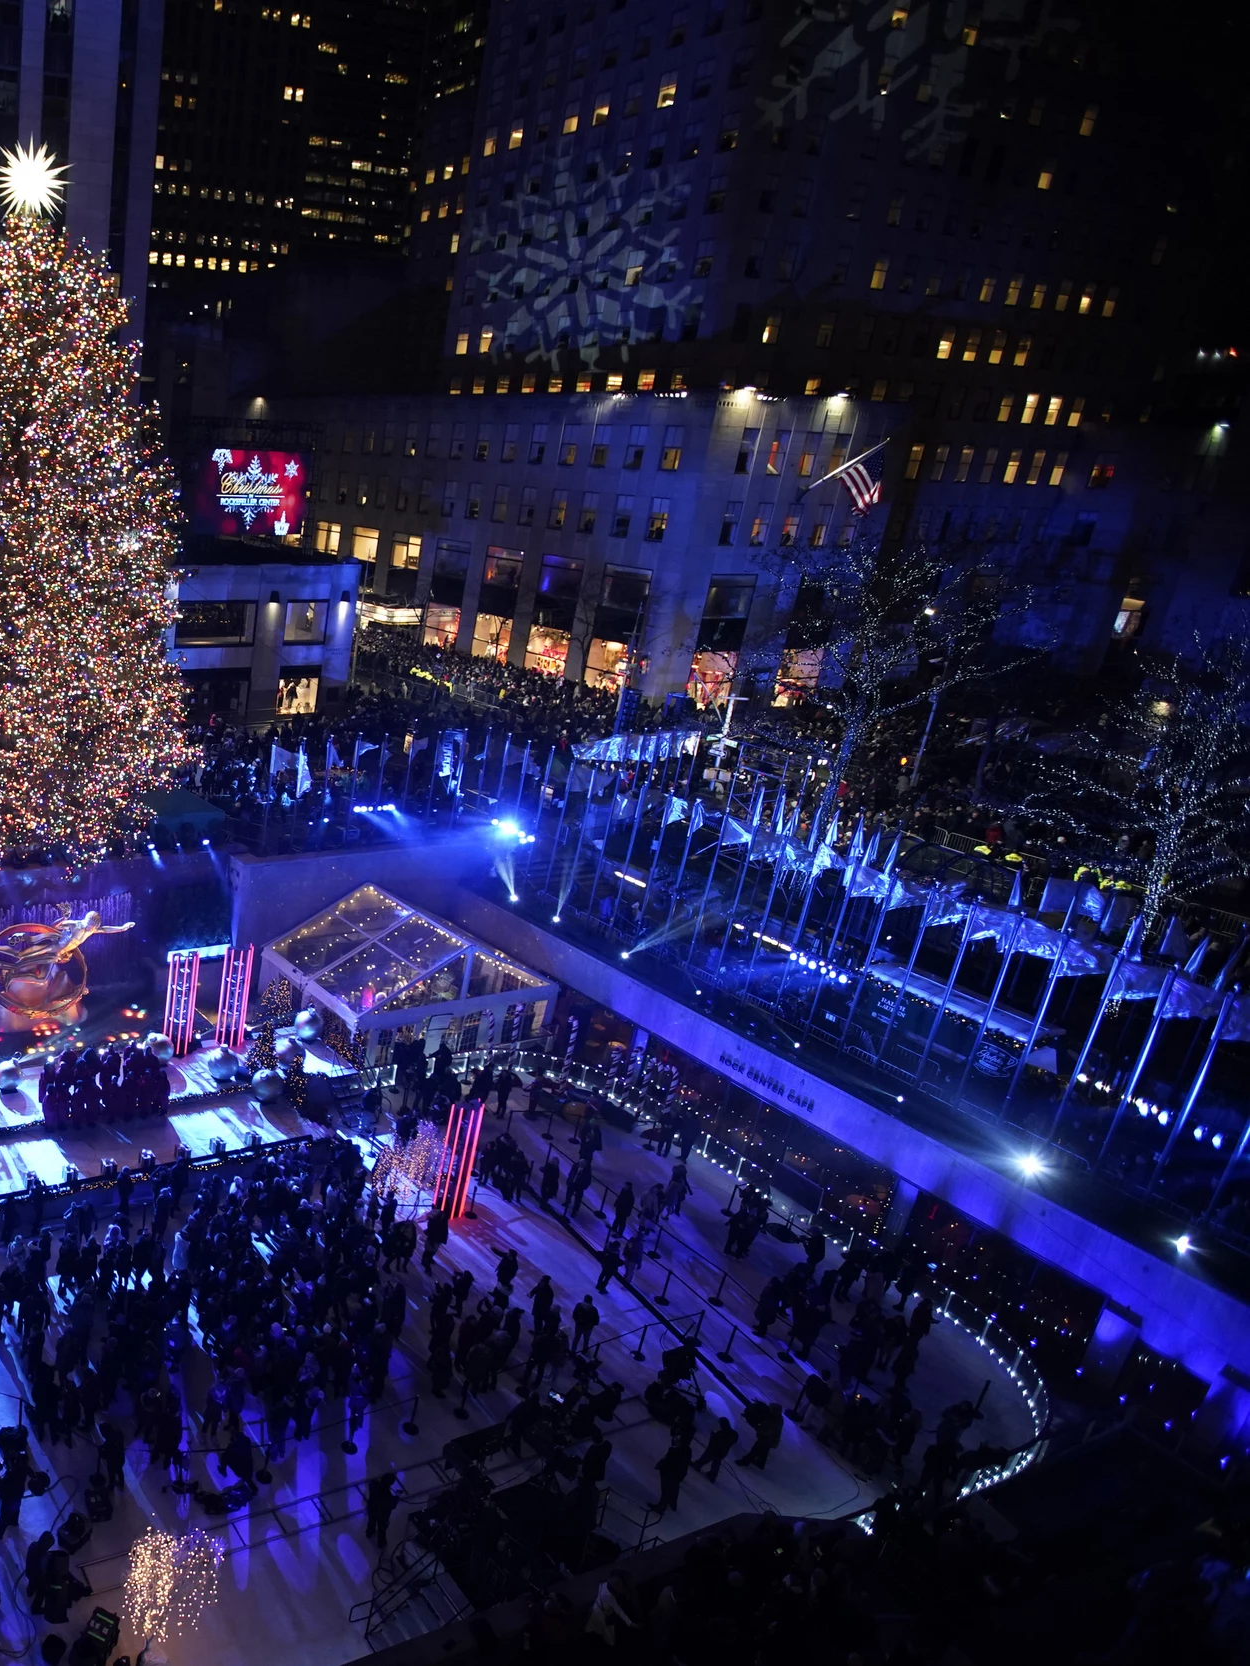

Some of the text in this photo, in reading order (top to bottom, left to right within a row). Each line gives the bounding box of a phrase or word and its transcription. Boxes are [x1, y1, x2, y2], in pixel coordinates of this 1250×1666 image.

[220, 471, 283, 495] Christmas
[258, 498, 280, 506] CENTER
[881, 997, 906, 1012] RALH
[719, 1053, 744, 1075] ROCK
[746, 1069, 786, 1097] CENTER
